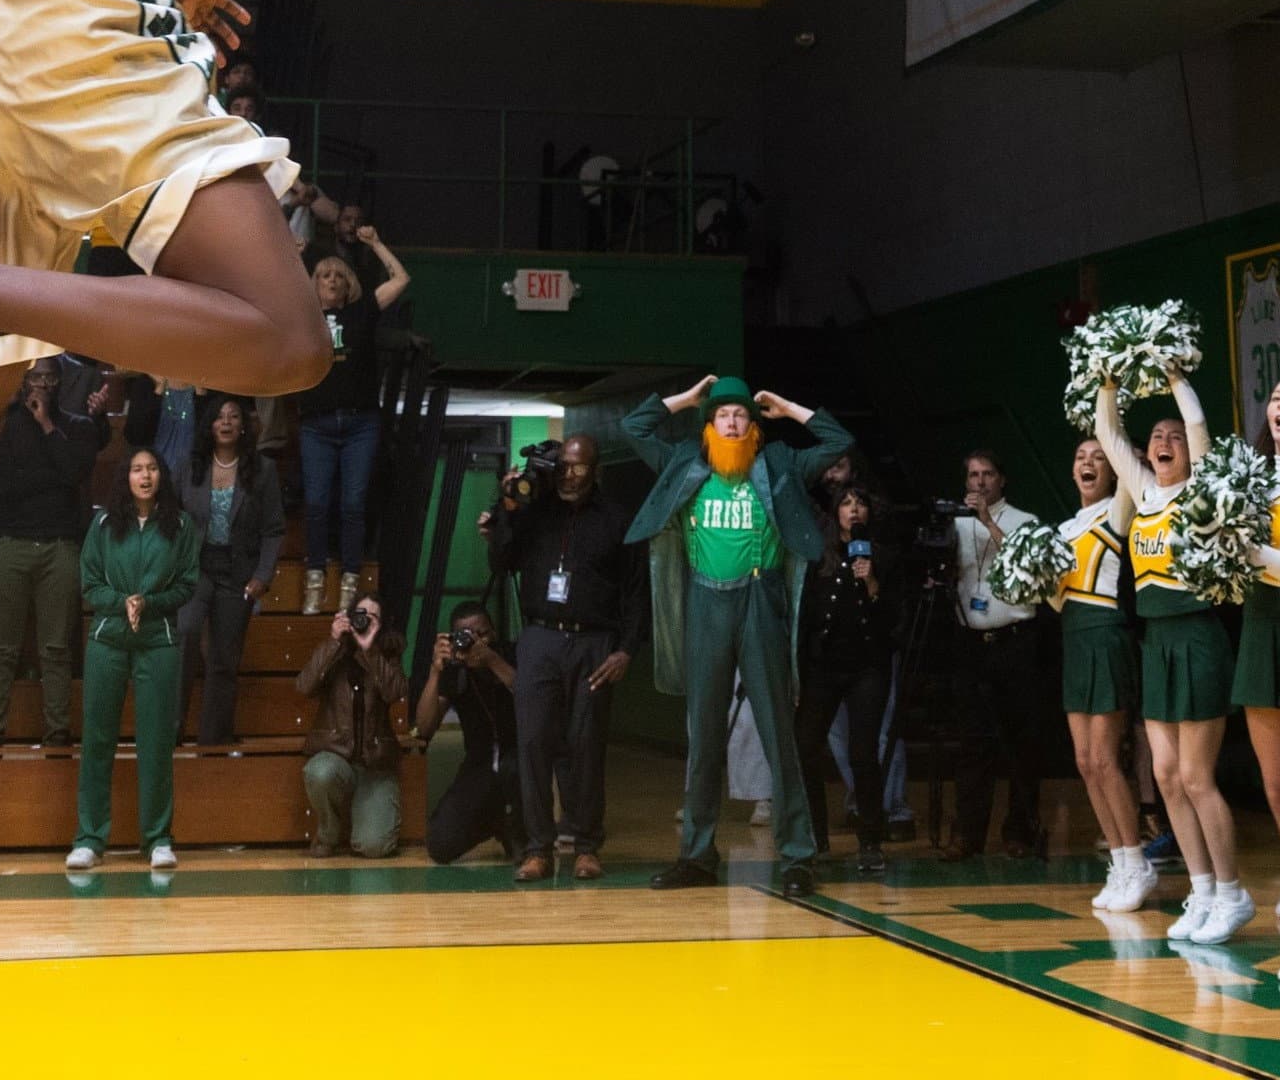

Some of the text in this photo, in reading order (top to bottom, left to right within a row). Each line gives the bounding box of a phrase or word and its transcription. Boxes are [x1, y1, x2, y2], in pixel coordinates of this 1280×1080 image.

[527, 272, 562, 299] EXIT
[1251, 342, 1280, 403] 30
[703, 499, 753, 530] IRISH
[1133, 530, 1166, 556] Irish
